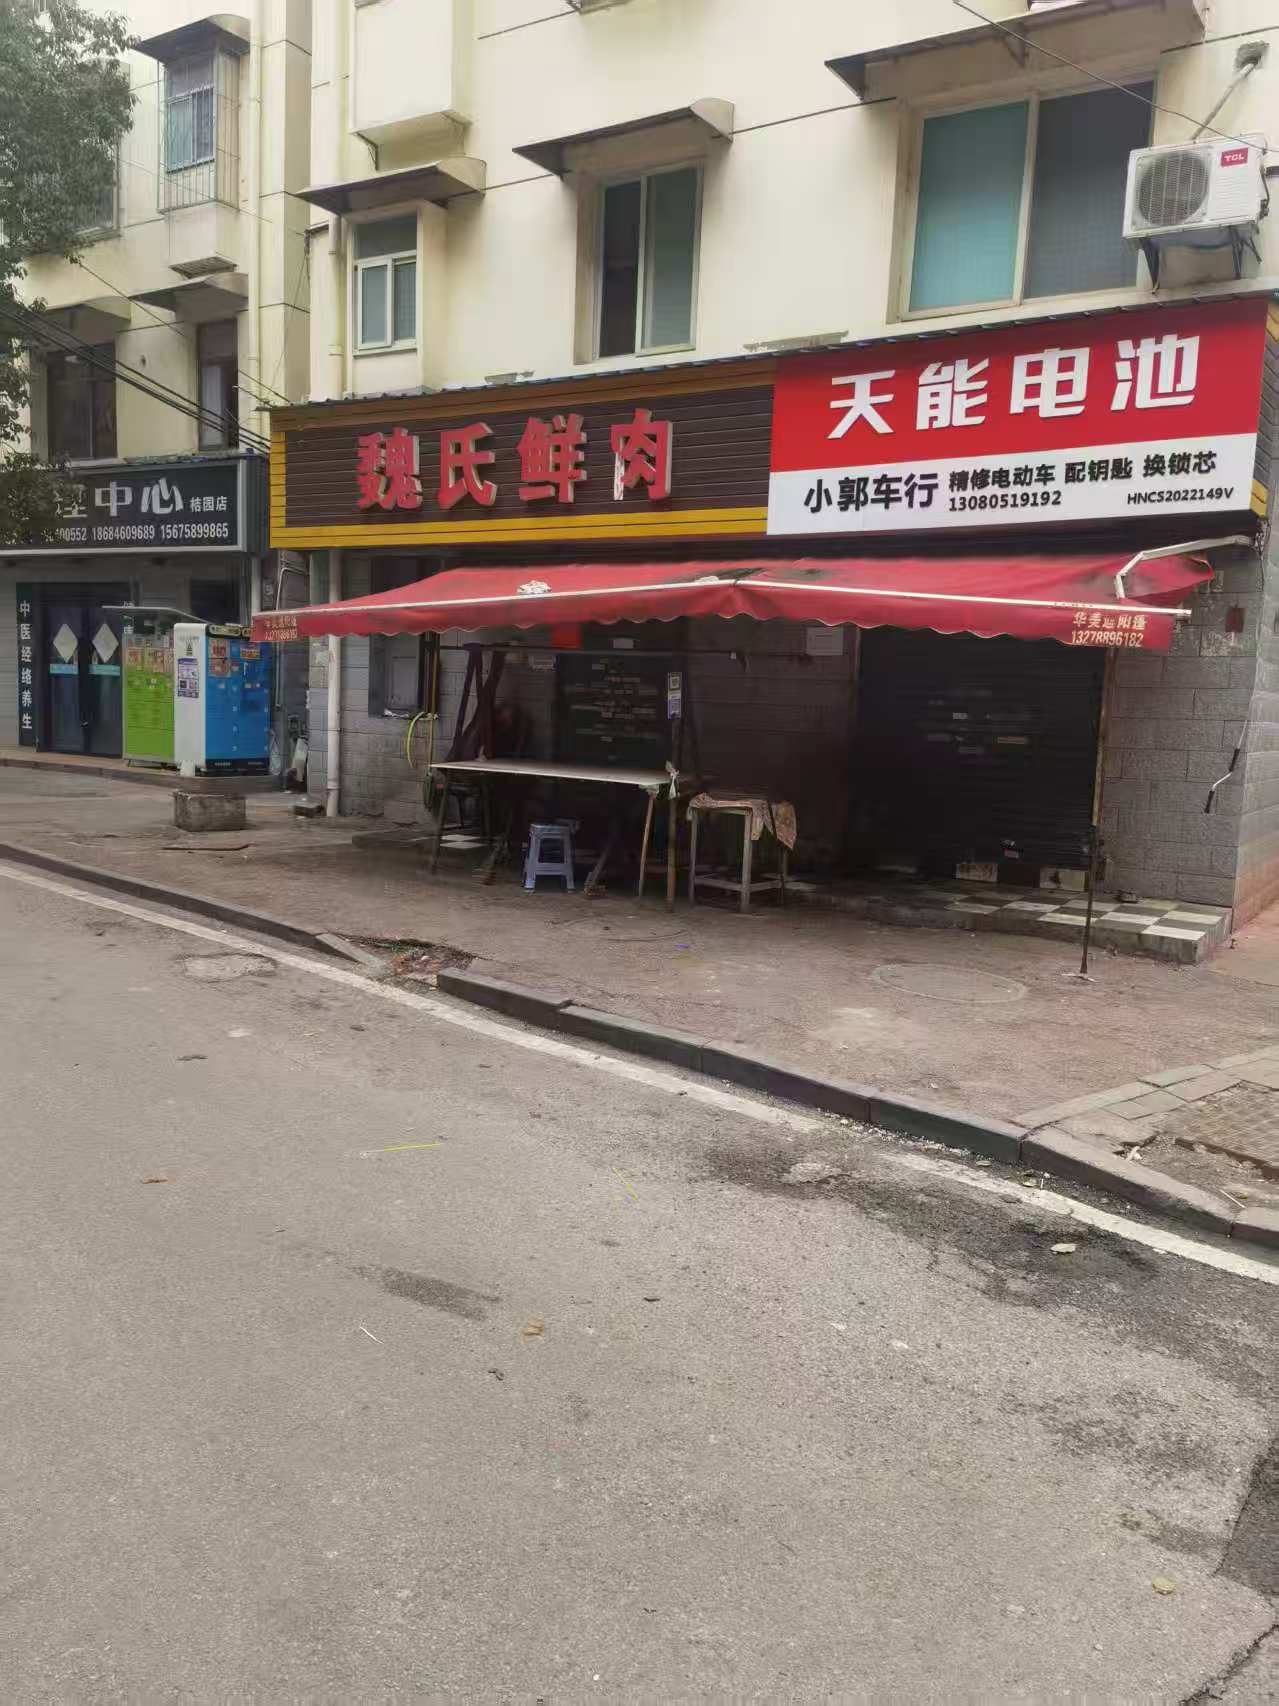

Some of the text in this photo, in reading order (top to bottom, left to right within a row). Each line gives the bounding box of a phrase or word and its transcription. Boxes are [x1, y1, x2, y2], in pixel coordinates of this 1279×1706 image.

[1223, 153, 1245, 162] TCL
[827, 334, 1200, 440] 天能电池
[356, 408, 674, 511] 魏氏鲜肉
[949, 450, 1217, 493] 精修电动车 配钥匙 换锁芯
[803, 472, 939, 514] 小郭车行
[948, 490, 1062, 512] 13080519192
[92, 525, 155, 541] 18684609689
[160, 522, 229, 539] 15675899865
